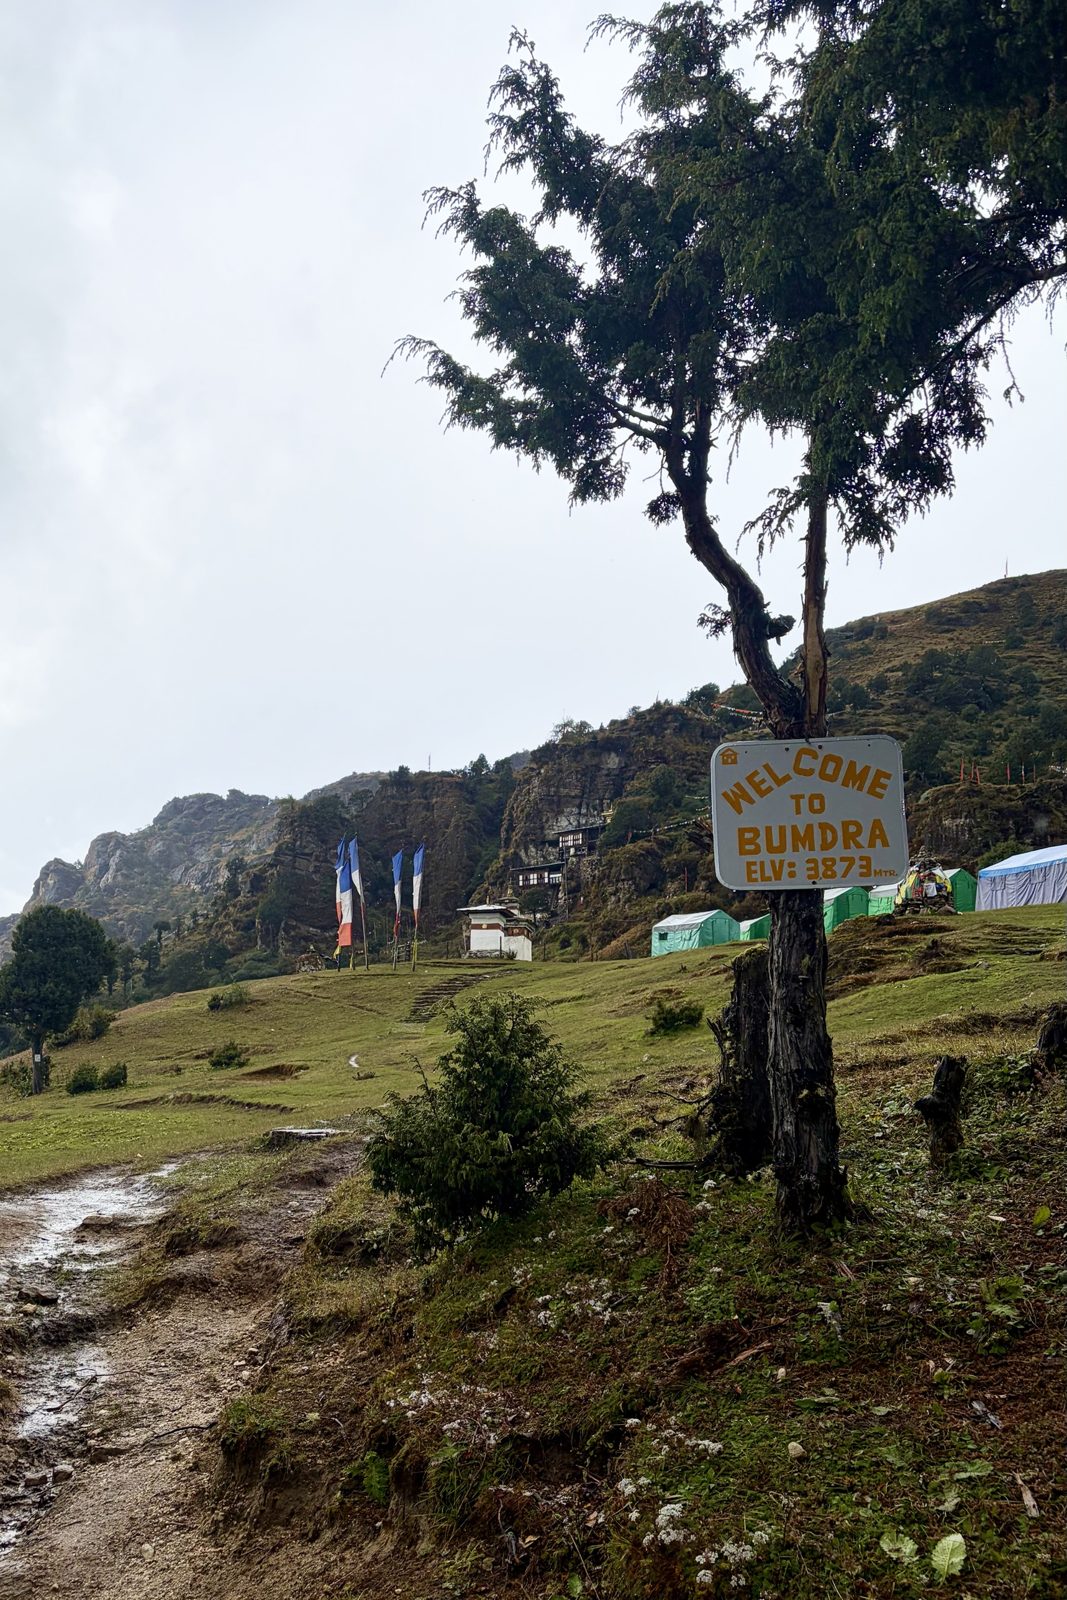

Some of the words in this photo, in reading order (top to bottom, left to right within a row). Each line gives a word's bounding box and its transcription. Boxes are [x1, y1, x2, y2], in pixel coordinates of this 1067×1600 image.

[721, 747, 892, 815] WELCOME
[790, 793, 826, 815] TO
[737, 818, 890, 856] BUMDRA
[745, 859, 797, 883] ELV:
[805, 856, 872, 880] 3873
